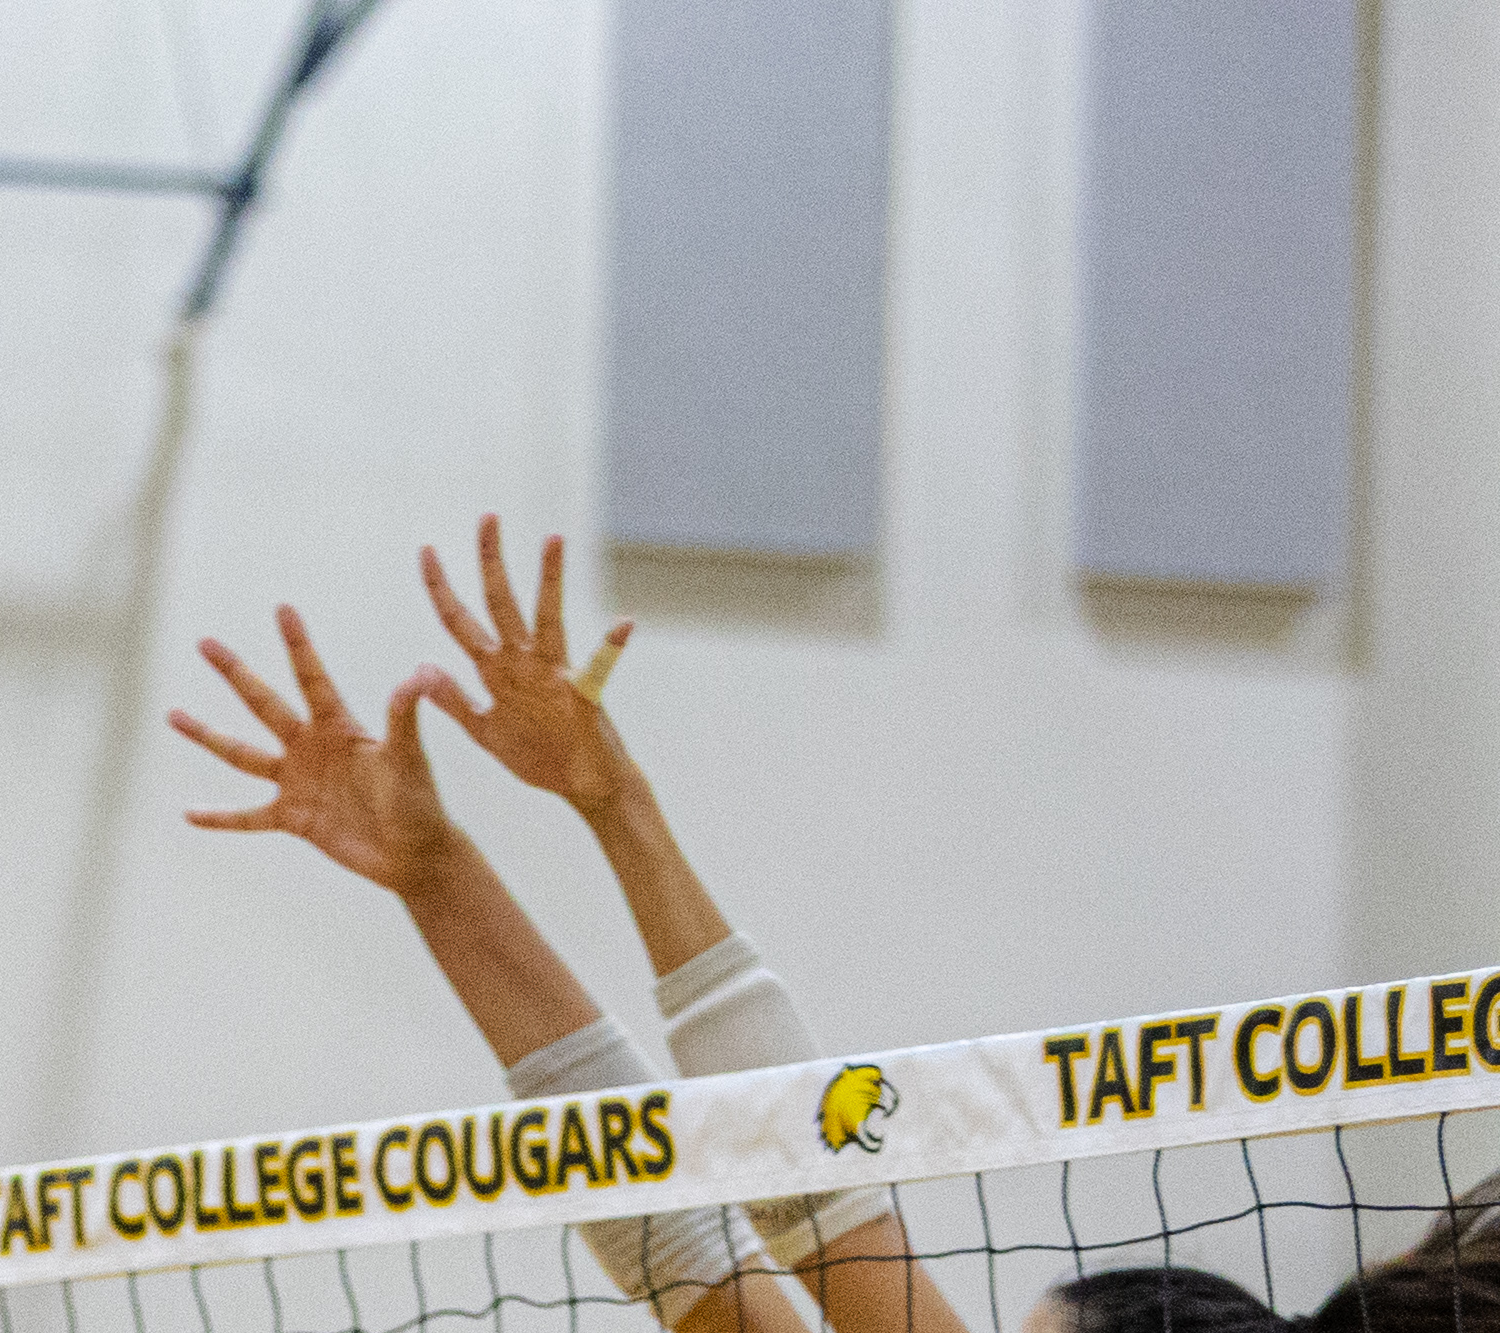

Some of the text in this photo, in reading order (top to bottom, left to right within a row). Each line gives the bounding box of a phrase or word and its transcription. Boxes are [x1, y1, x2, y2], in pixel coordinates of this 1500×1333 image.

[1042, 1012, 1222, 1128] TAFT
[108, 1130, 366, 1240] COLLEGE
[370, 1090, 676, 1212] COUGARS
